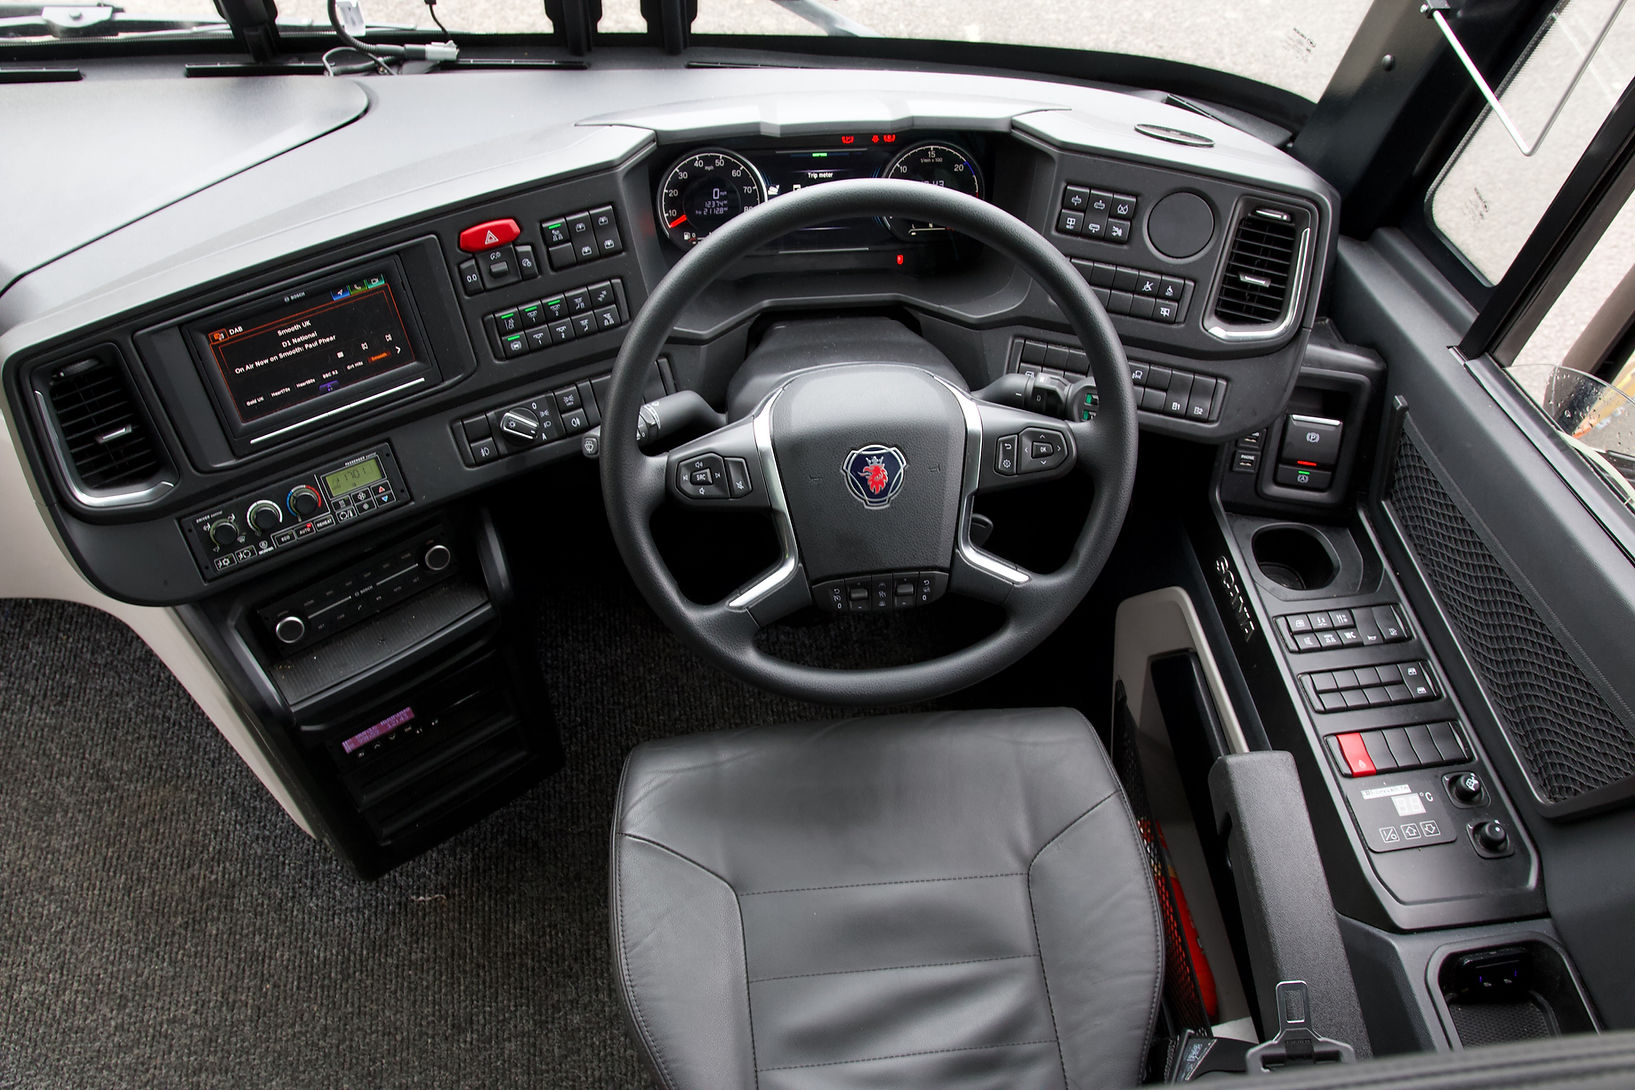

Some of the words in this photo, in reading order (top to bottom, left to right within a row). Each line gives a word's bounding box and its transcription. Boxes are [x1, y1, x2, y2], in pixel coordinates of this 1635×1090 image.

[693, 160, 704, 168] 40
[715, 159, 725, 167] 50
[953, 164, 964, 172] 20
[678, 171, 688, 179] 30
[731, 169, 742, 177] 60
[668, 189, 679, 197] 20
[712, 188, 720, 200] 0
[743, 186, 753, 194] 70
[668, 209, 677, 217] 10
[228, 325, 244, 336] DAB
[277, 323, 301, 337] Smooth
[301, 319, 312, 328] UK
[281, 339, 291, 348] D1
[291, 330, 318, 344] National
[234, 366, 245, 375] On
[245, 363, 254, 371] Air
[254, 358, 269, 368] Now
[269, 355, 279, 363] on
[304, 341, 319, 351] Paul
[318, 334, 336, 345] Phear
[1343, 631, 1357, 640] WC
